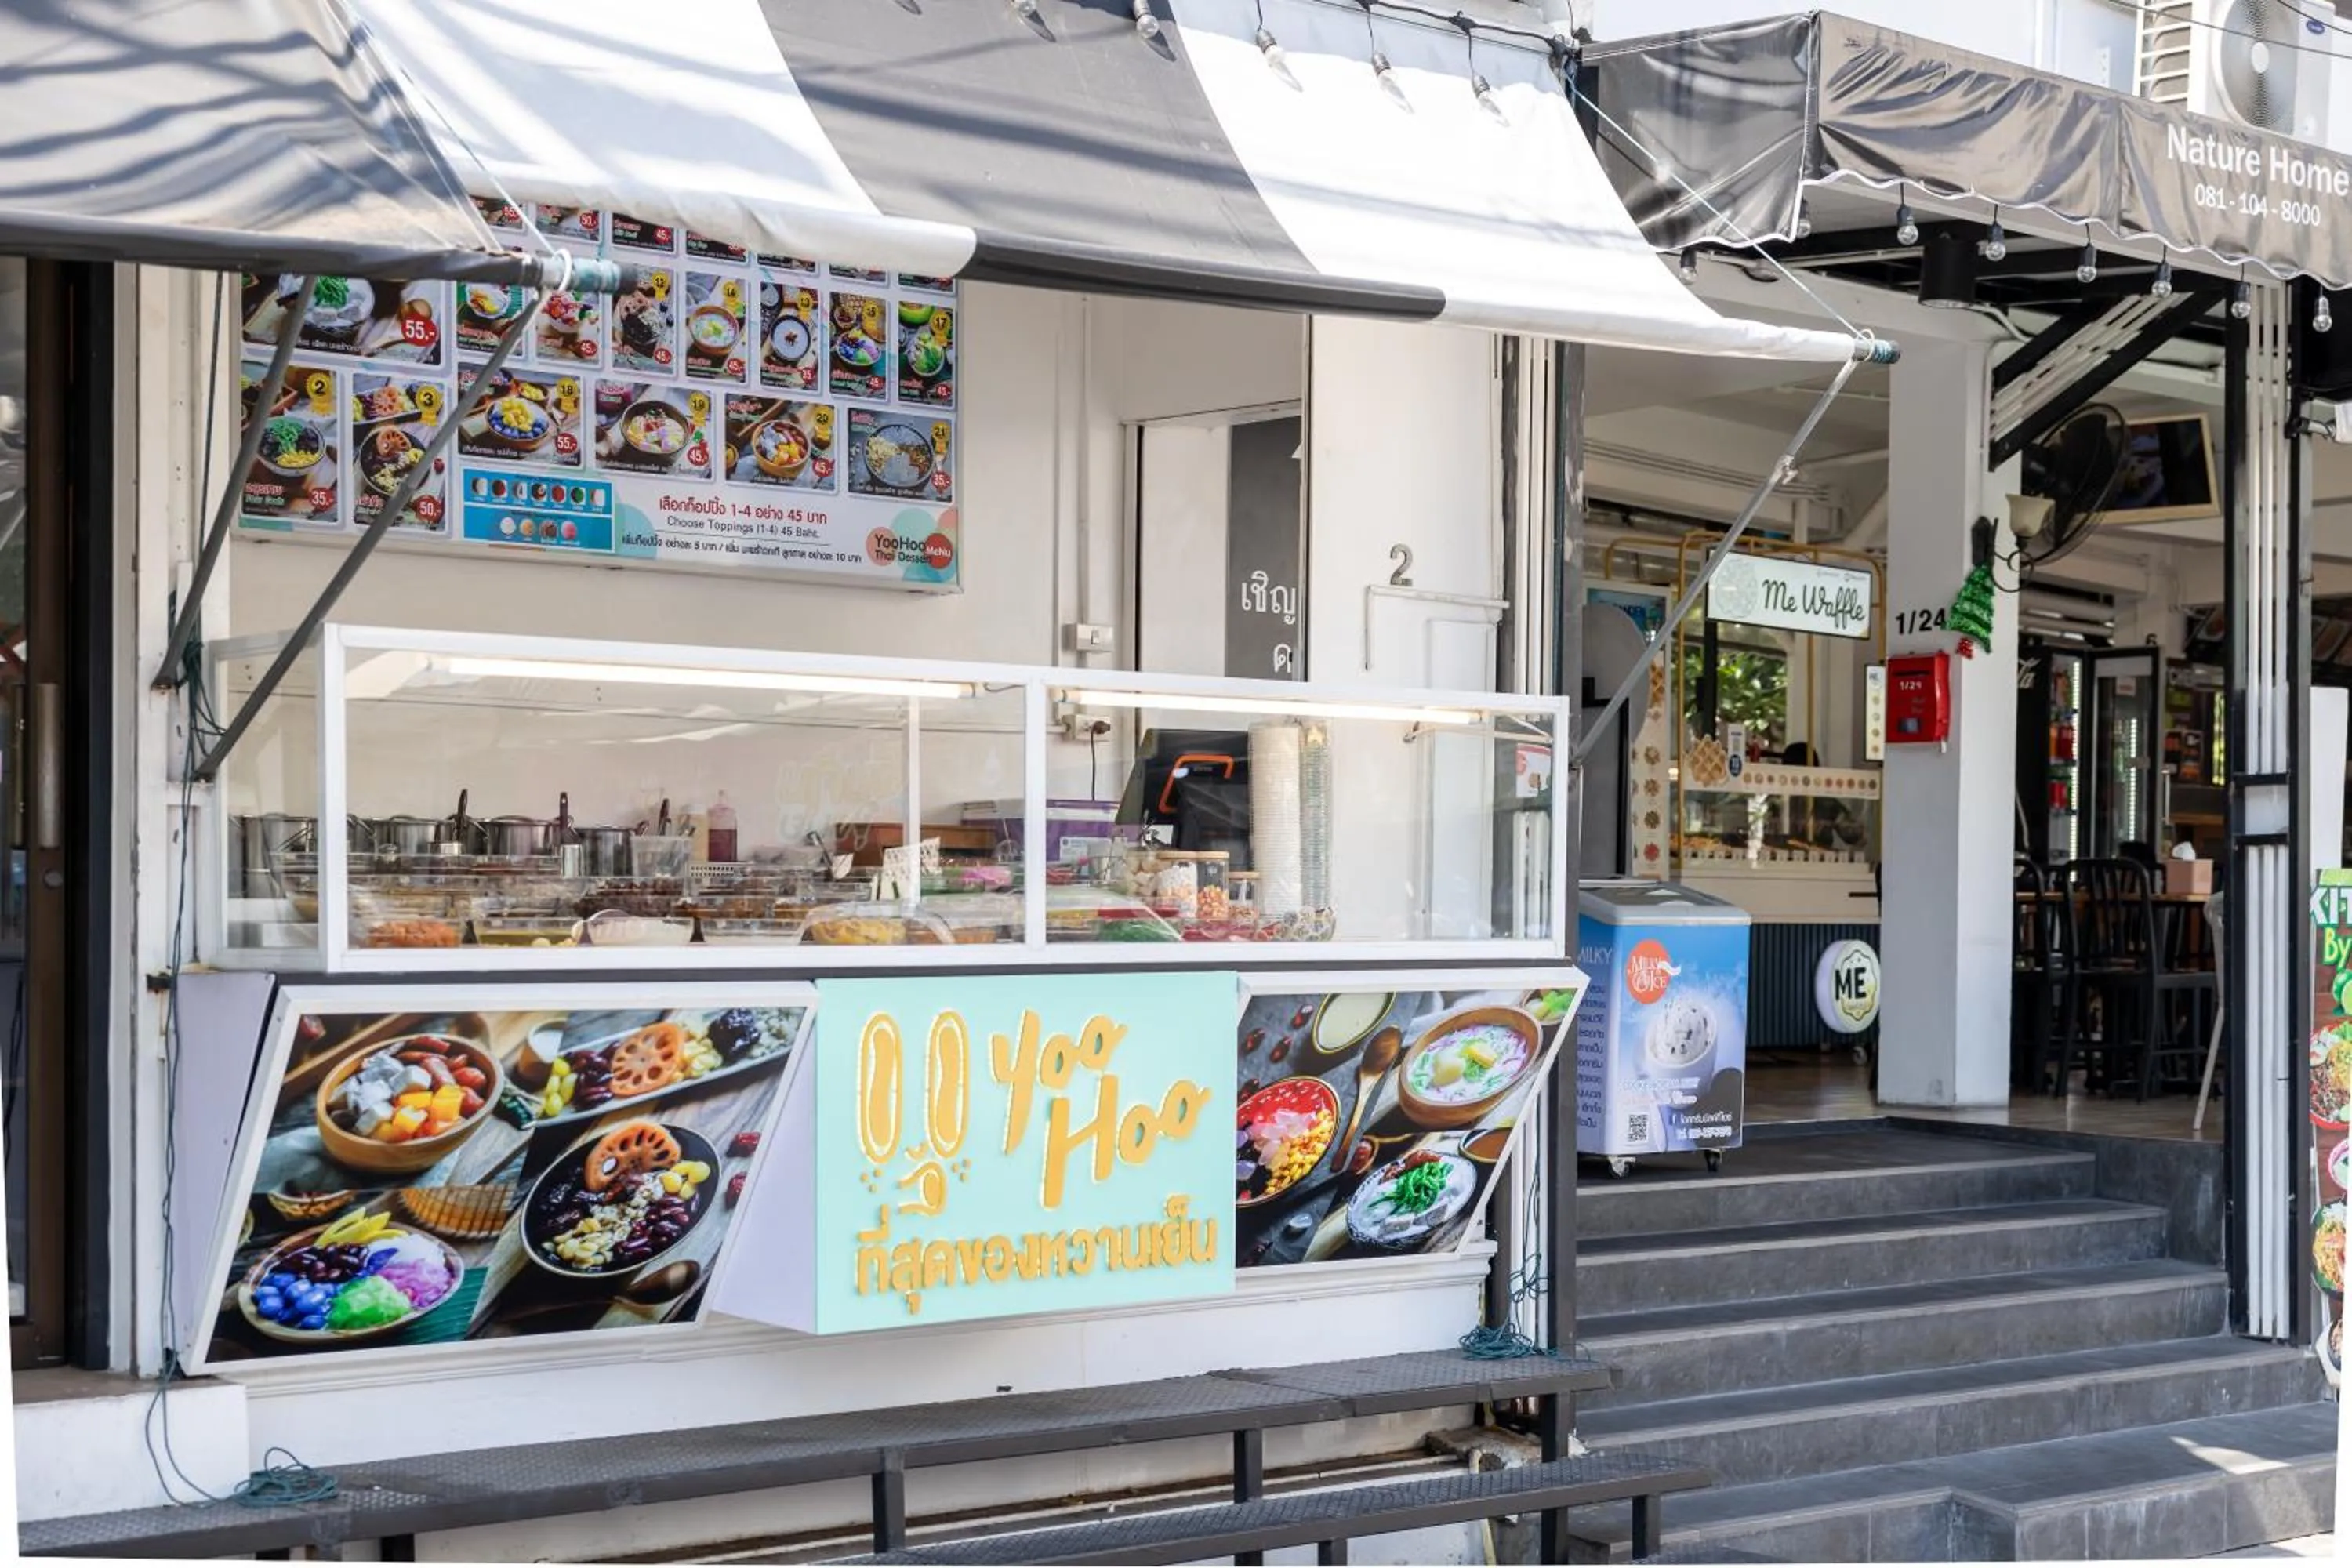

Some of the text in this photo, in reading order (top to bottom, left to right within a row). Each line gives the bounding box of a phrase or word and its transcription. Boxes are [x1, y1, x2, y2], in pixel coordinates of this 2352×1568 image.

[2168, 123, 2350, 196] Nature Home
[2195, 183, 2227, 209] 081
[2239, 193, 2268, 218] 104
[2281, 200, 2321, 227] 8000
[405, 319, 435, 341] 55.-
[935, 317, 946, 327] 17
[314, 380, 325, 394] 2
[561, 385, 573, 396] 18
[423, 393, 434, 406] 3
[815, 413, 829, 423] 20
[934, 426, 946, 437] 21
[557, 437, 576, 450] 55.-
[311, 491, 334, 506] 35.-
[419, 502, 442, 516] 50.-
[731, 504, 751, 517] 1-4
[755, 505, 782, 521] อย่าง
[788, 510, 802, 522] 45
[807, 512, 827, 524] บาท
[667, 516, 704, 528] Choose
[708, 519, 753, 535] Toppings
[781, 526, 793, 536] 45
[695, 541, 700, 550] 5
[836, 553, 846, 562] 10
[874, 534, 927, 551] YooHoo
[1390, 543, 1413, 586] 2
[1241, 570, 1296, 624] เชิญ
[1762, 579, 1865, 630] Me Waffle
[1896, 608, 1947, 634] 1/24
[2323, 927, 2351, 971] By
[1835, 967, 1866, 1001] ME
[992, 1007, 1128, 1155] Yoo
[1042, 1072, 1211, 1210] Hoo
[856, 1193, 1218, 1315] ที่สุดของหวานเย็น
